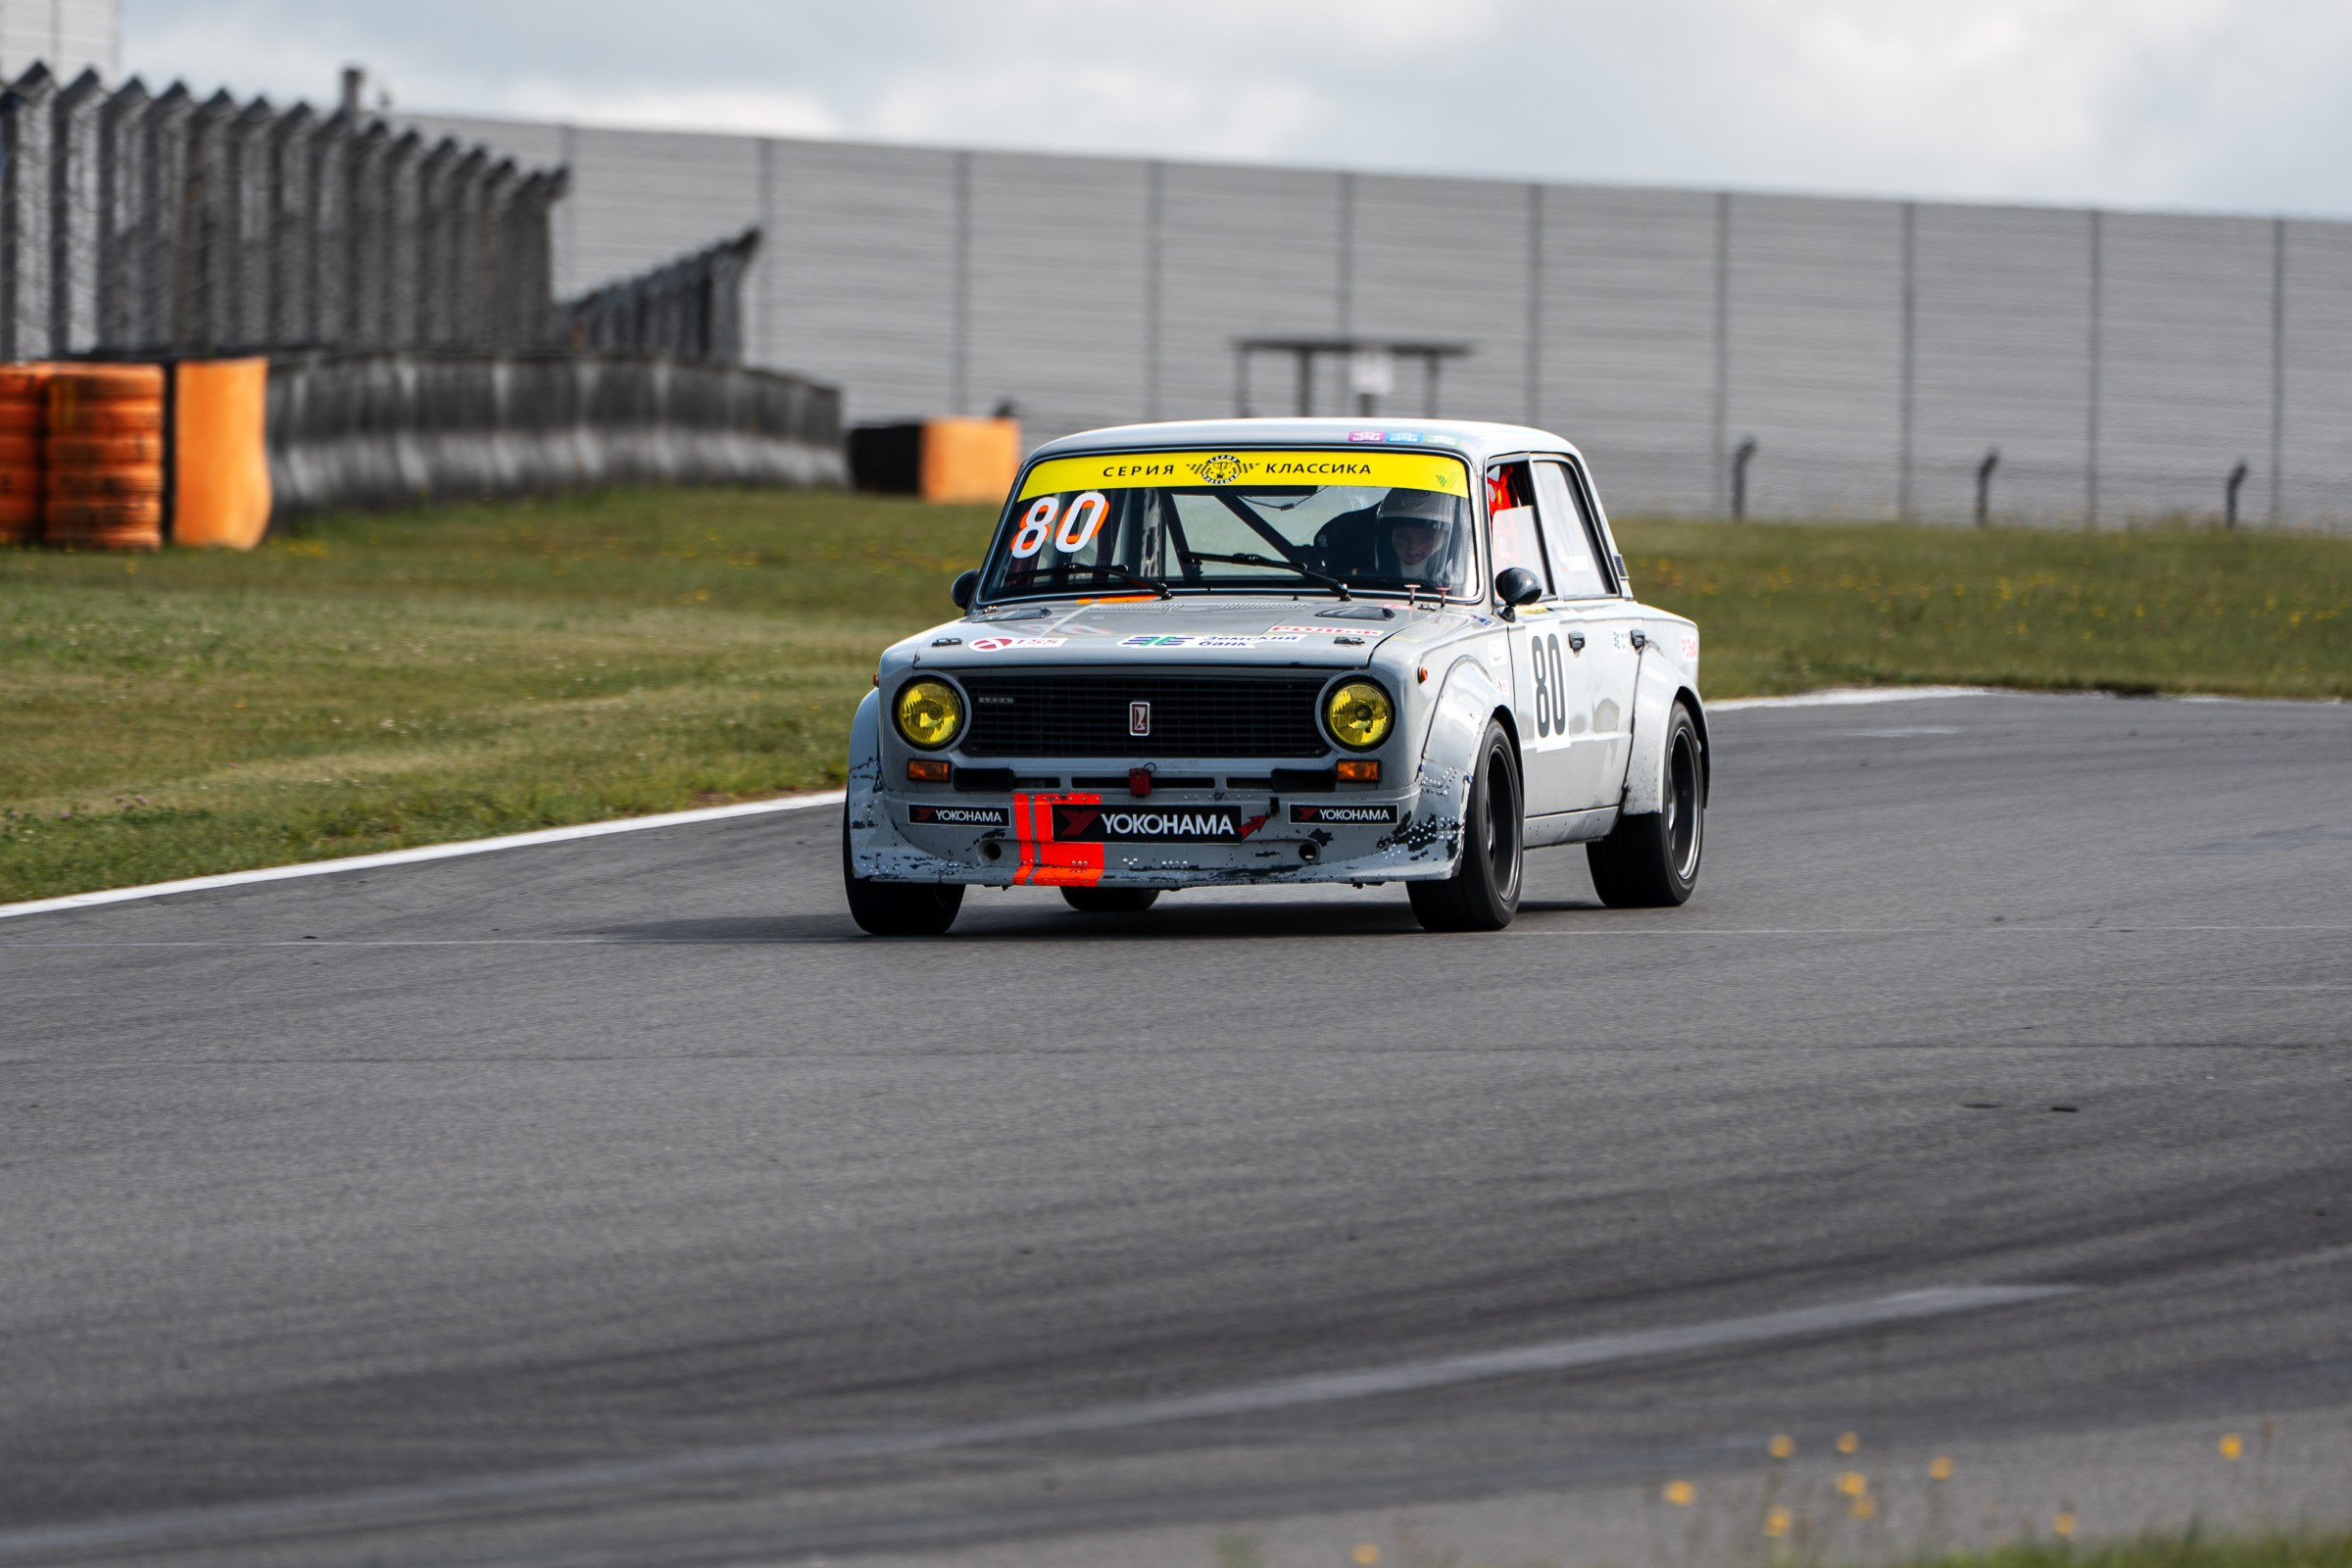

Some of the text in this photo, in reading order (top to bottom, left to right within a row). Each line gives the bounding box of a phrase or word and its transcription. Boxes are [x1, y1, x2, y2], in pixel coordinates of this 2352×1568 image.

[1102, 463, 1371, 477] СЕРИЯ КЛАССИКА
[1010, 492, 1109, 559] 80
[1532, 633, 1566, 738] 80
[935, 809, 1002, 822] YOKOHAMA
[1319, 808, 1390, 821] YOKOHAMA
[1101, 813, 1235, 835] YOKOHAMA
